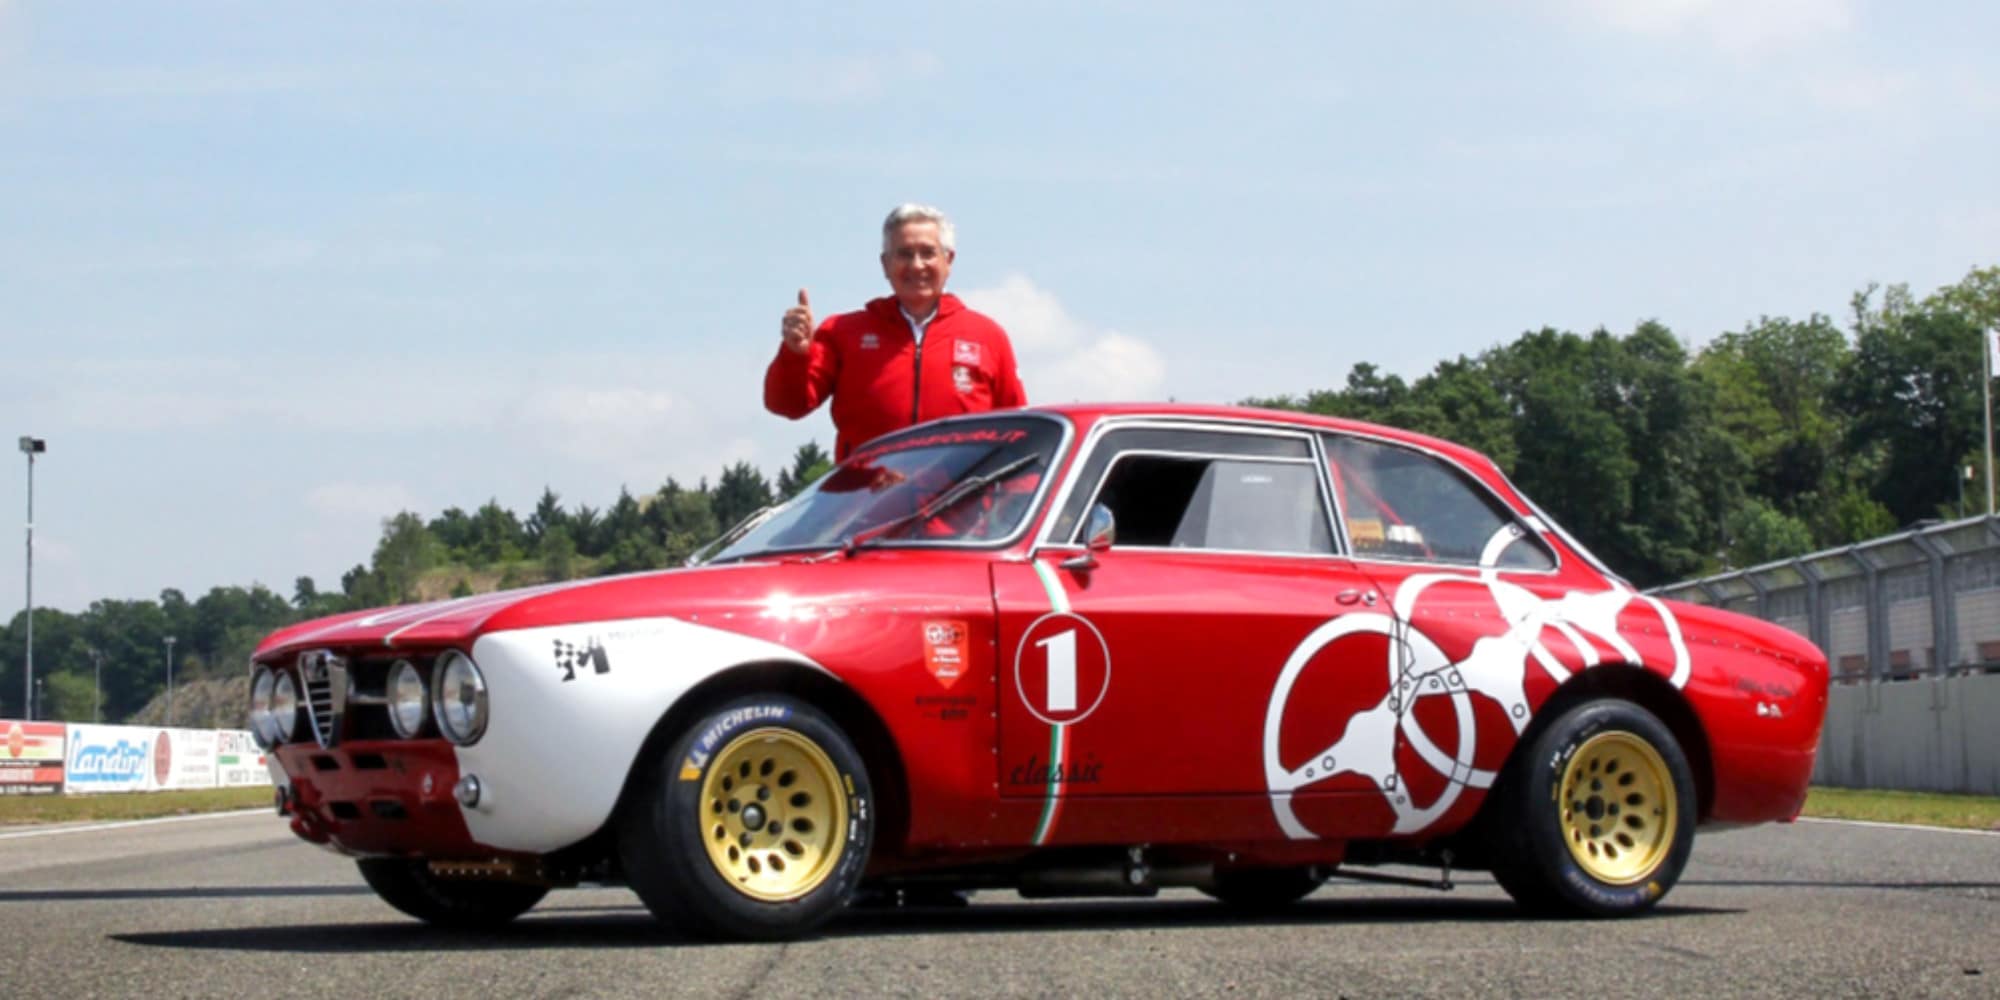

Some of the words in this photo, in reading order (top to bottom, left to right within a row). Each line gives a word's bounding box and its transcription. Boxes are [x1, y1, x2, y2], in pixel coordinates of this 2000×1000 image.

[1035, 628, 1077, 711] 1
[702, 706, 785, 750] MICHELIN
[1008, 754, 1103, 785] classic
